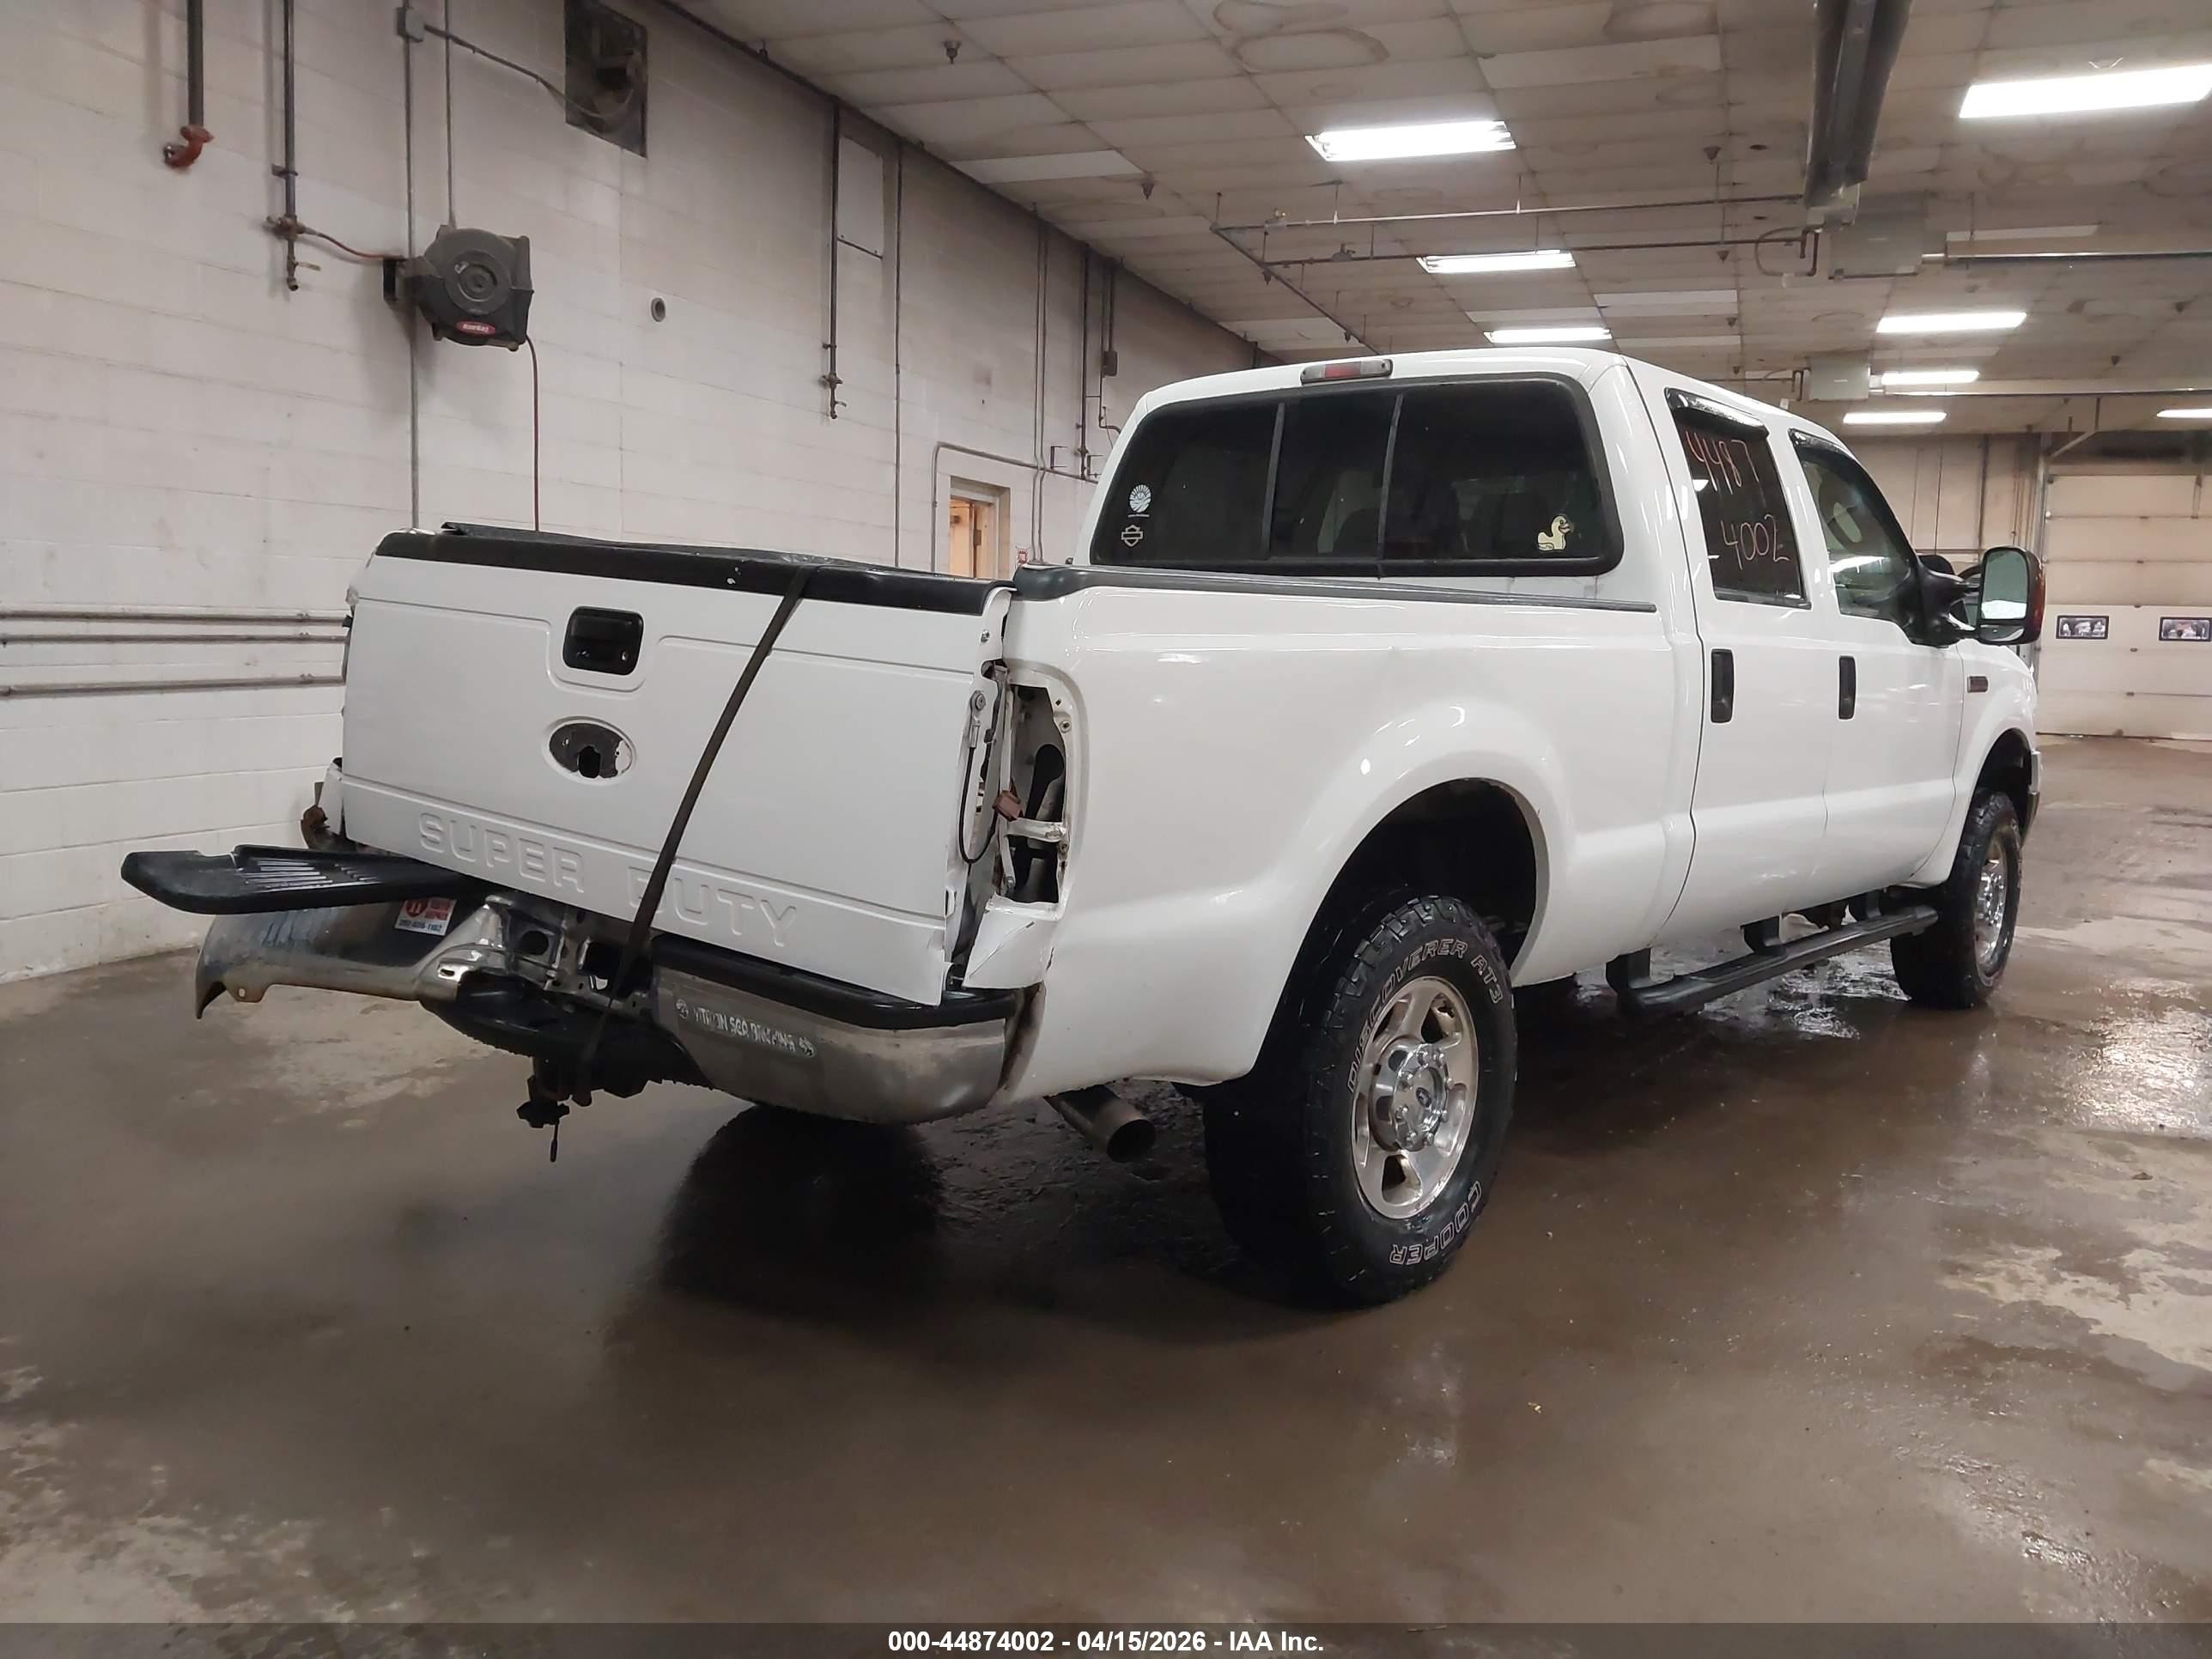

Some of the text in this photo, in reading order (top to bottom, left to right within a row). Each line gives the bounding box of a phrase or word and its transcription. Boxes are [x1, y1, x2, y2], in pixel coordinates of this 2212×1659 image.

[1685, 430, 1760, 495] 4487
[1720, 514, 1791, 571] 4002
[418, 811, 586, 894] SUPER
[1469, 954, 1504, 1005] AT3
[1389, 1180, 1482, 1266] COOPER
